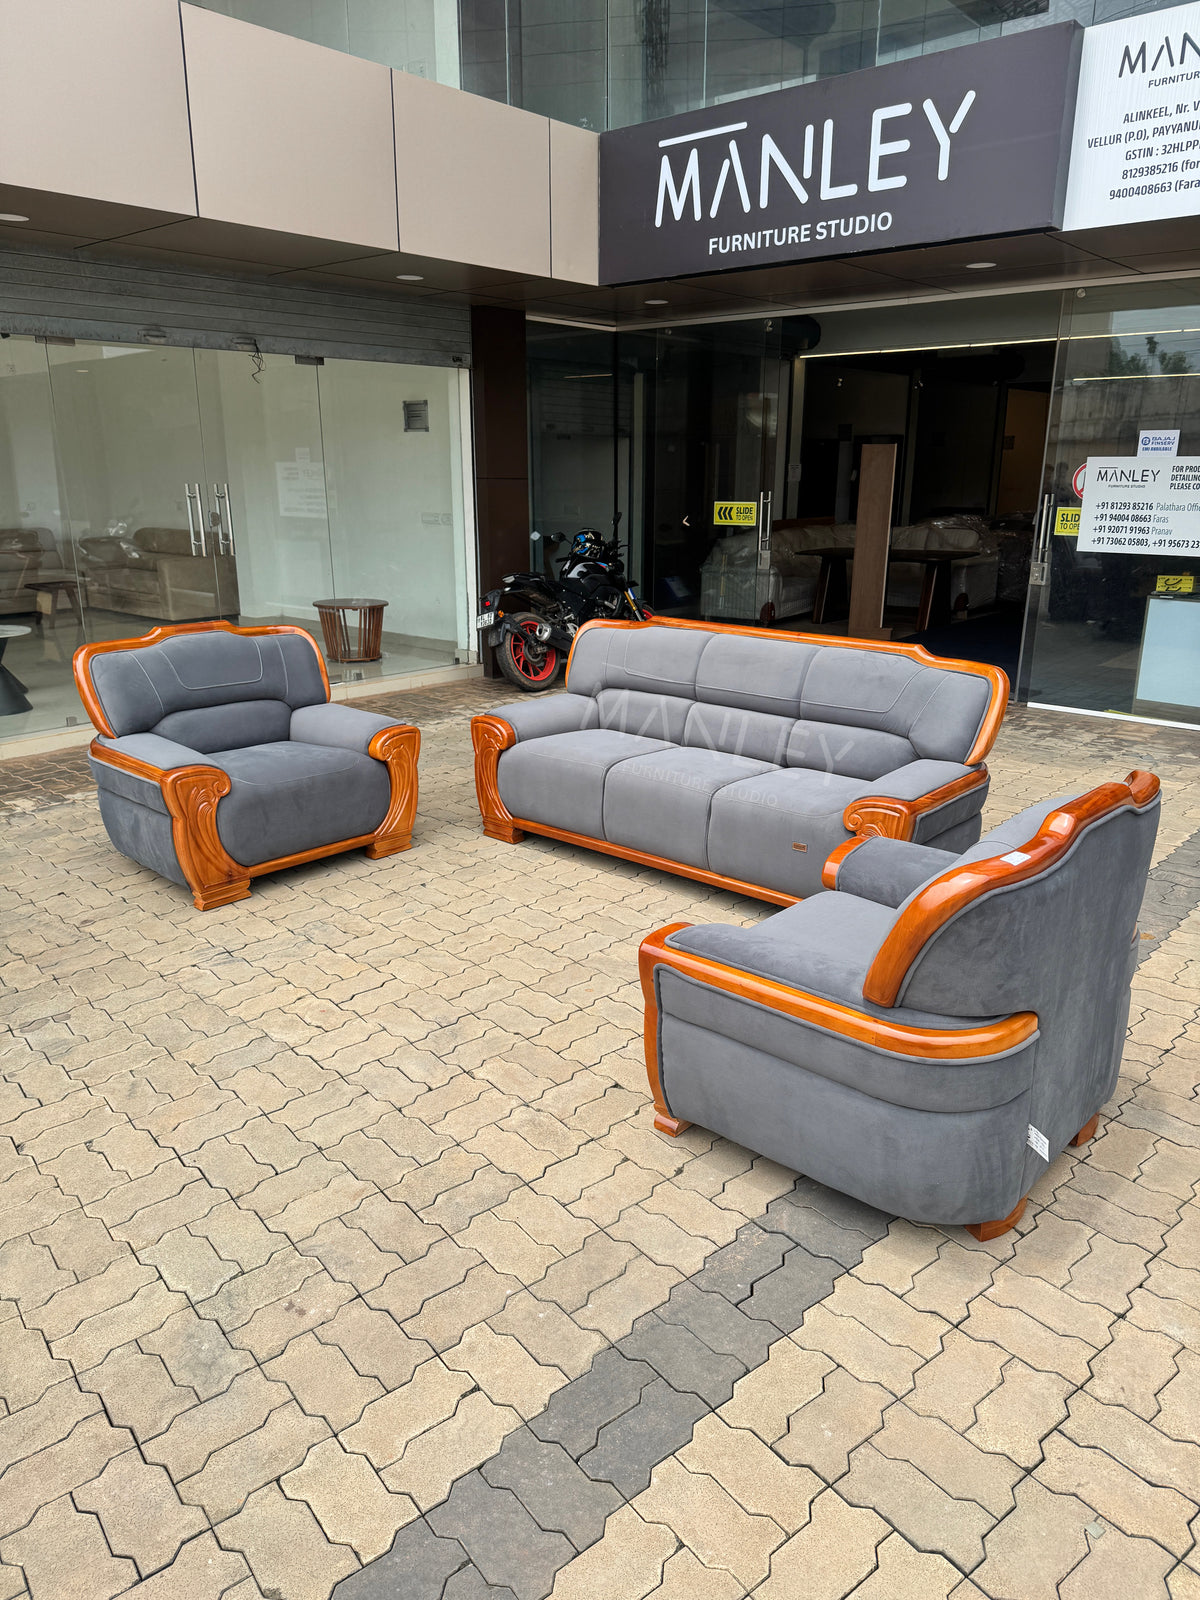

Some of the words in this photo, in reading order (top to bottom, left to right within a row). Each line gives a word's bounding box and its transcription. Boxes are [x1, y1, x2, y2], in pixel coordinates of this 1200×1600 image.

[1123, 105, 1173, 124] ALINKEEL,
[1175, 102, 1190, 115] Nr.
[1087, 133, 1122, 149] VELLUR
[1124, 128, 1150, 144] (P.O),
[1152, 119, 1200, 138] PAYYANU
[1125, 146, 1154, 161] GSTIN
[1160, 138, 1200, 156] 32HLPP
[654, 89, 977, 228] MANLEY
[1121, 161, 1178, 180] 8129385216
[1109, 181, 1172, 201] 9400408663
[708, 223, 812, 255] FURNITURE
[815, 211, 893, 240] STUDIO
[1096, 466, 1161, 482] MANLEY
[1172, 465, 1184, 473] FOR
[1169, 482, 1192, 490] PLEASE
[735, 506, 754, 515] SLIDE
[1096, 502, 1109, 510] +91
[1110, 502, 1131, 510] 81293
[1132, 502, 1154, 511] 85216
[1156, 502, 1186, 511] Palathara
[1187, 502, 1200, 511] Offi
[1060, 512, 1080, 523] SLID
[1094, 514, 1108, 522] +91
[1109, 514, 1129, 522] 94004
[1131, 514, 1152, 523] 08663
[1153, 514, 1169, 523] Faras
[1060, 522, 1068, 530] TO
[1092, 525, 1106, 533] +91
[1107, 525, 1128, 534] 92071
[1129, 526, 1150, 535] 91963
[1151, 526, 1173, 535] Pranav
[1091, 537, 1105, 545] +91
[1106, 537, 1127, 546] 73062
[1127, 538, 1150, 548] 05803,
[1152, 539, 1166, 547] +91
[1167, 539, 1190, 548] 95673
